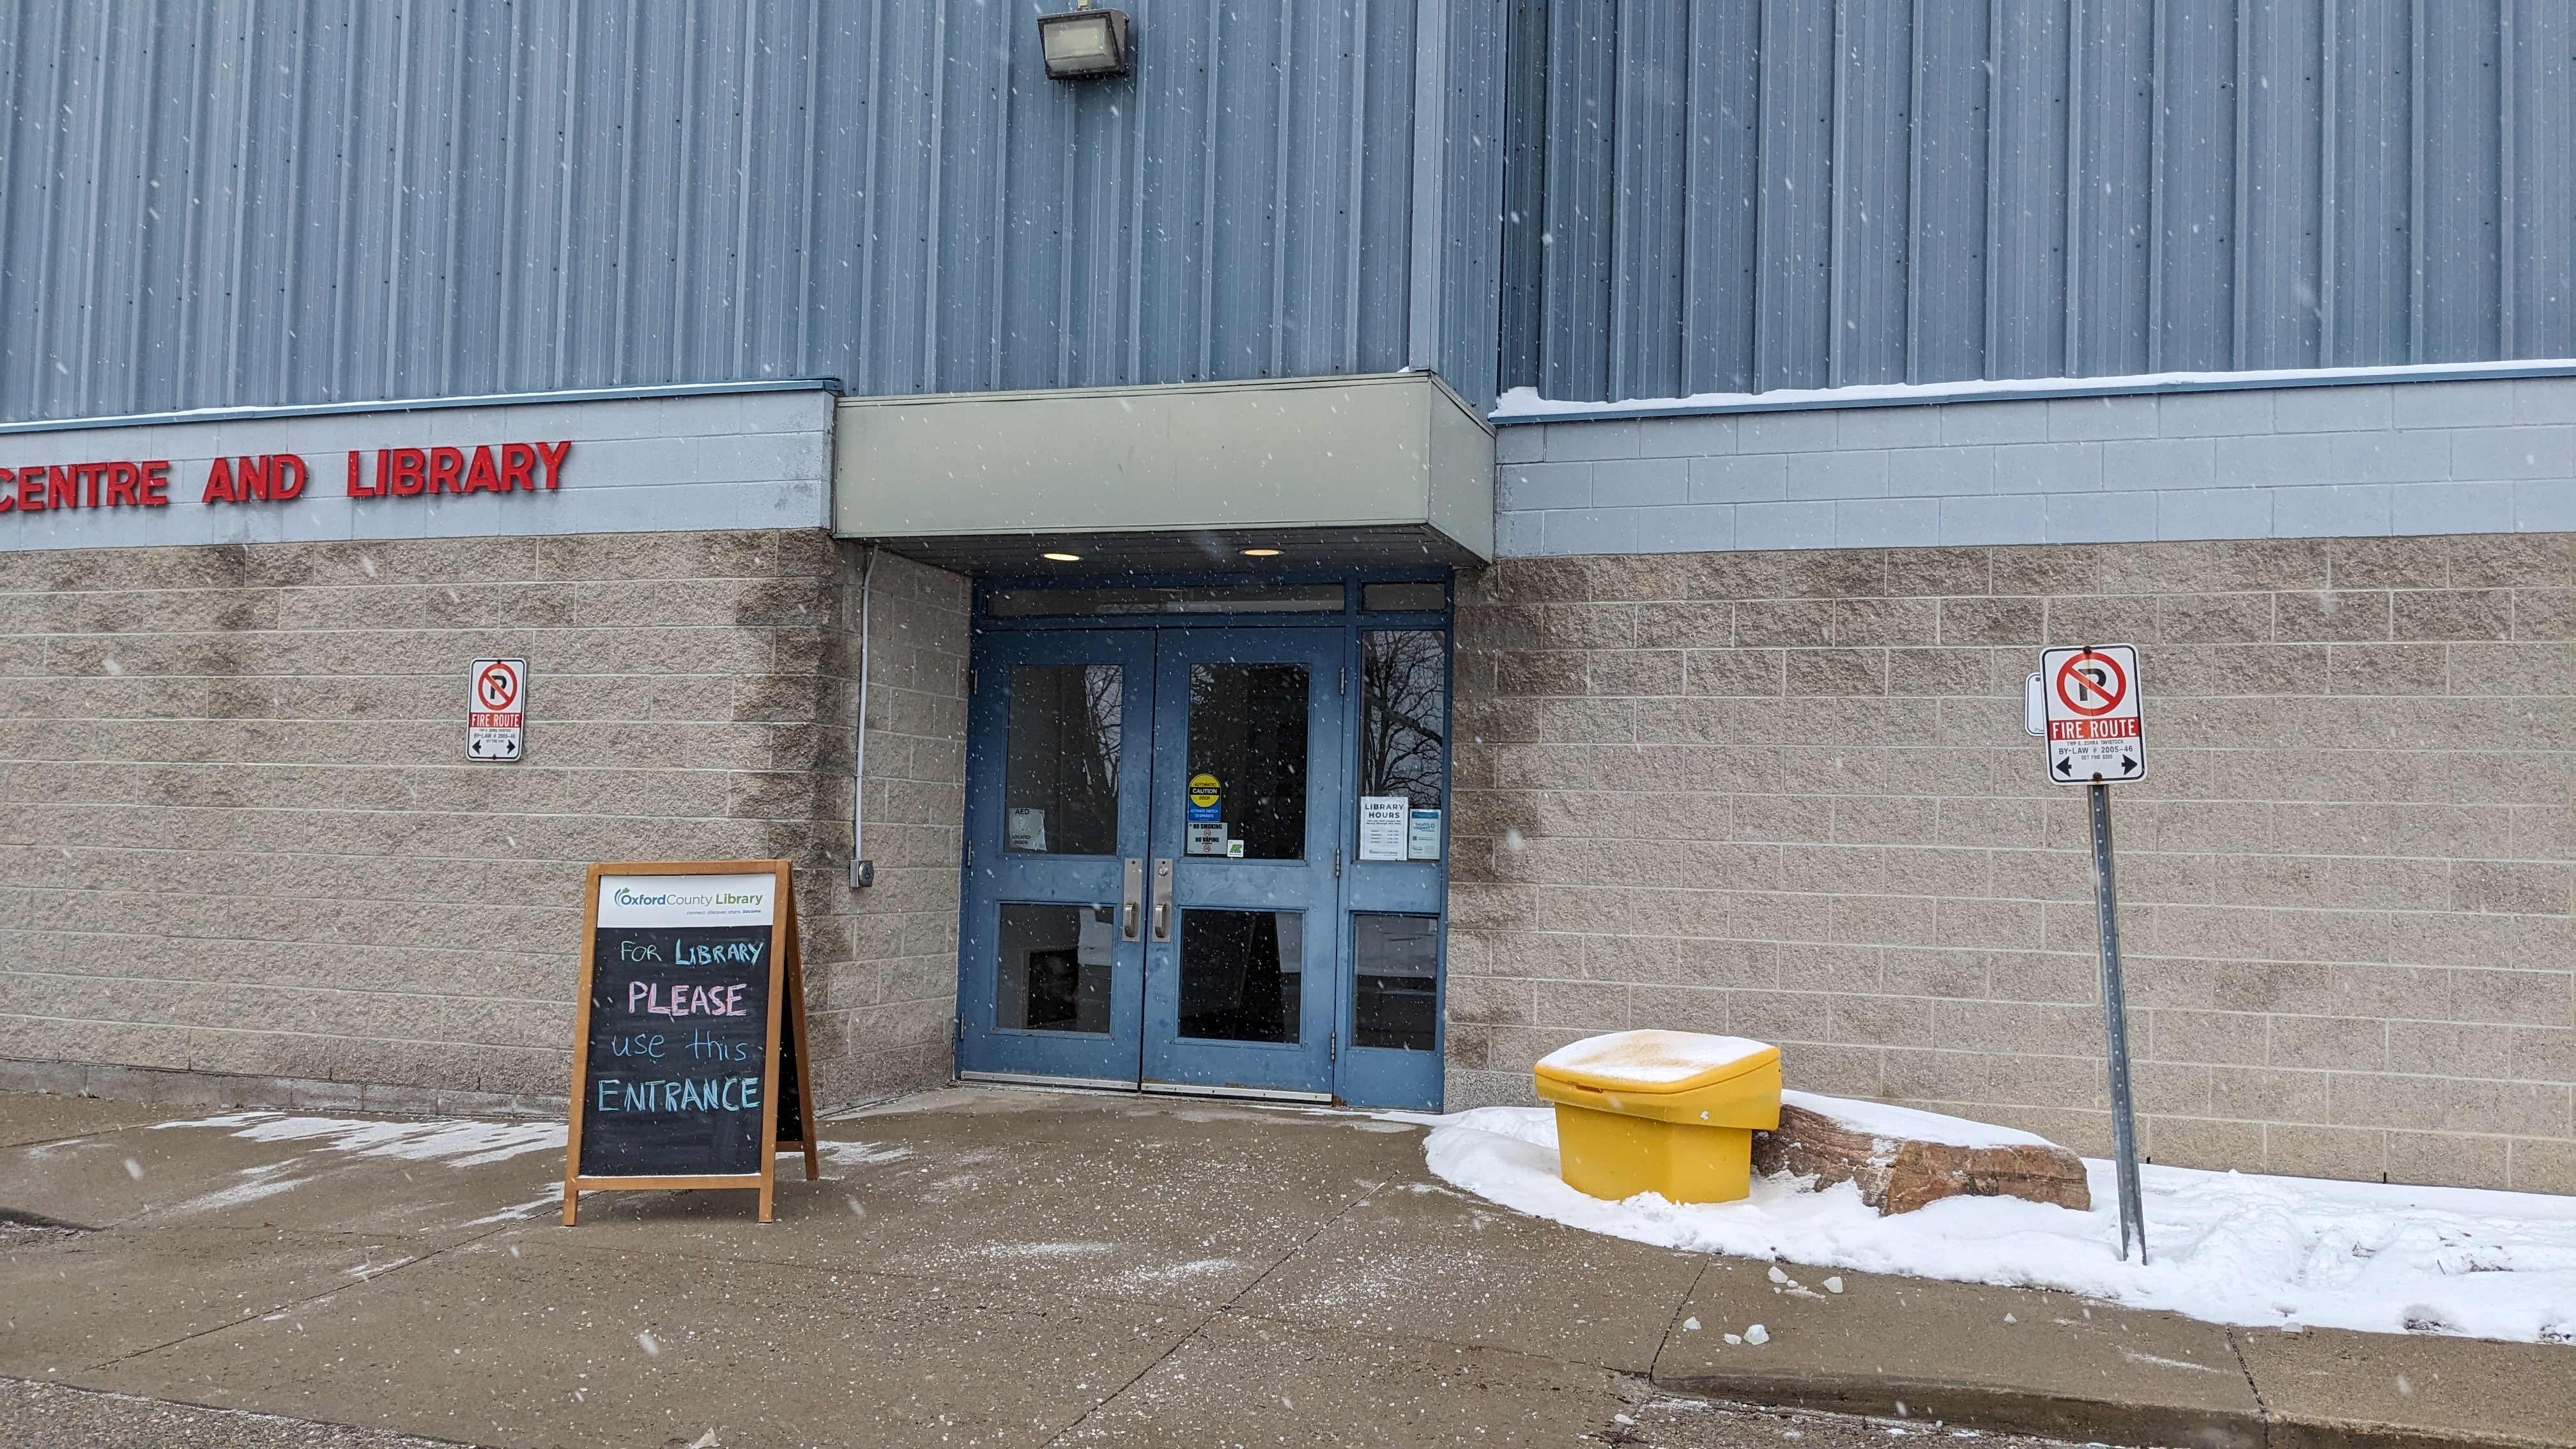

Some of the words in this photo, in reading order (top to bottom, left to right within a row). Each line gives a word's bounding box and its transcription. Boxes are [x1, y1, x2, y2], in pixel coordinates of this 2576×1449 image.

[0, 460, 169, 512] CENTRE
[202, 454, 307, 503] AND
[347, 441, 572, 497] LIBRARY
[471, 714, 491, 727] FIRE
[493, 714, 520, 727] ROUTE
[2052, 721, 2083, 739] FIRE
[2090, 719, 2136, 738] ROUTE
[2101, 745, 2133, 753] 2005-46
[716, 893, 763, 905] Library
[621, 941, 662, 962] FOR
[675, 939, 764, 966] LIBRARY
[629, 981, 747, 1016] PLEASE
[611, 1032, 666, 1058] use
[685, 1029, 747, 1061] this
[599, 1077, 760, 1112] ENTRANCE
